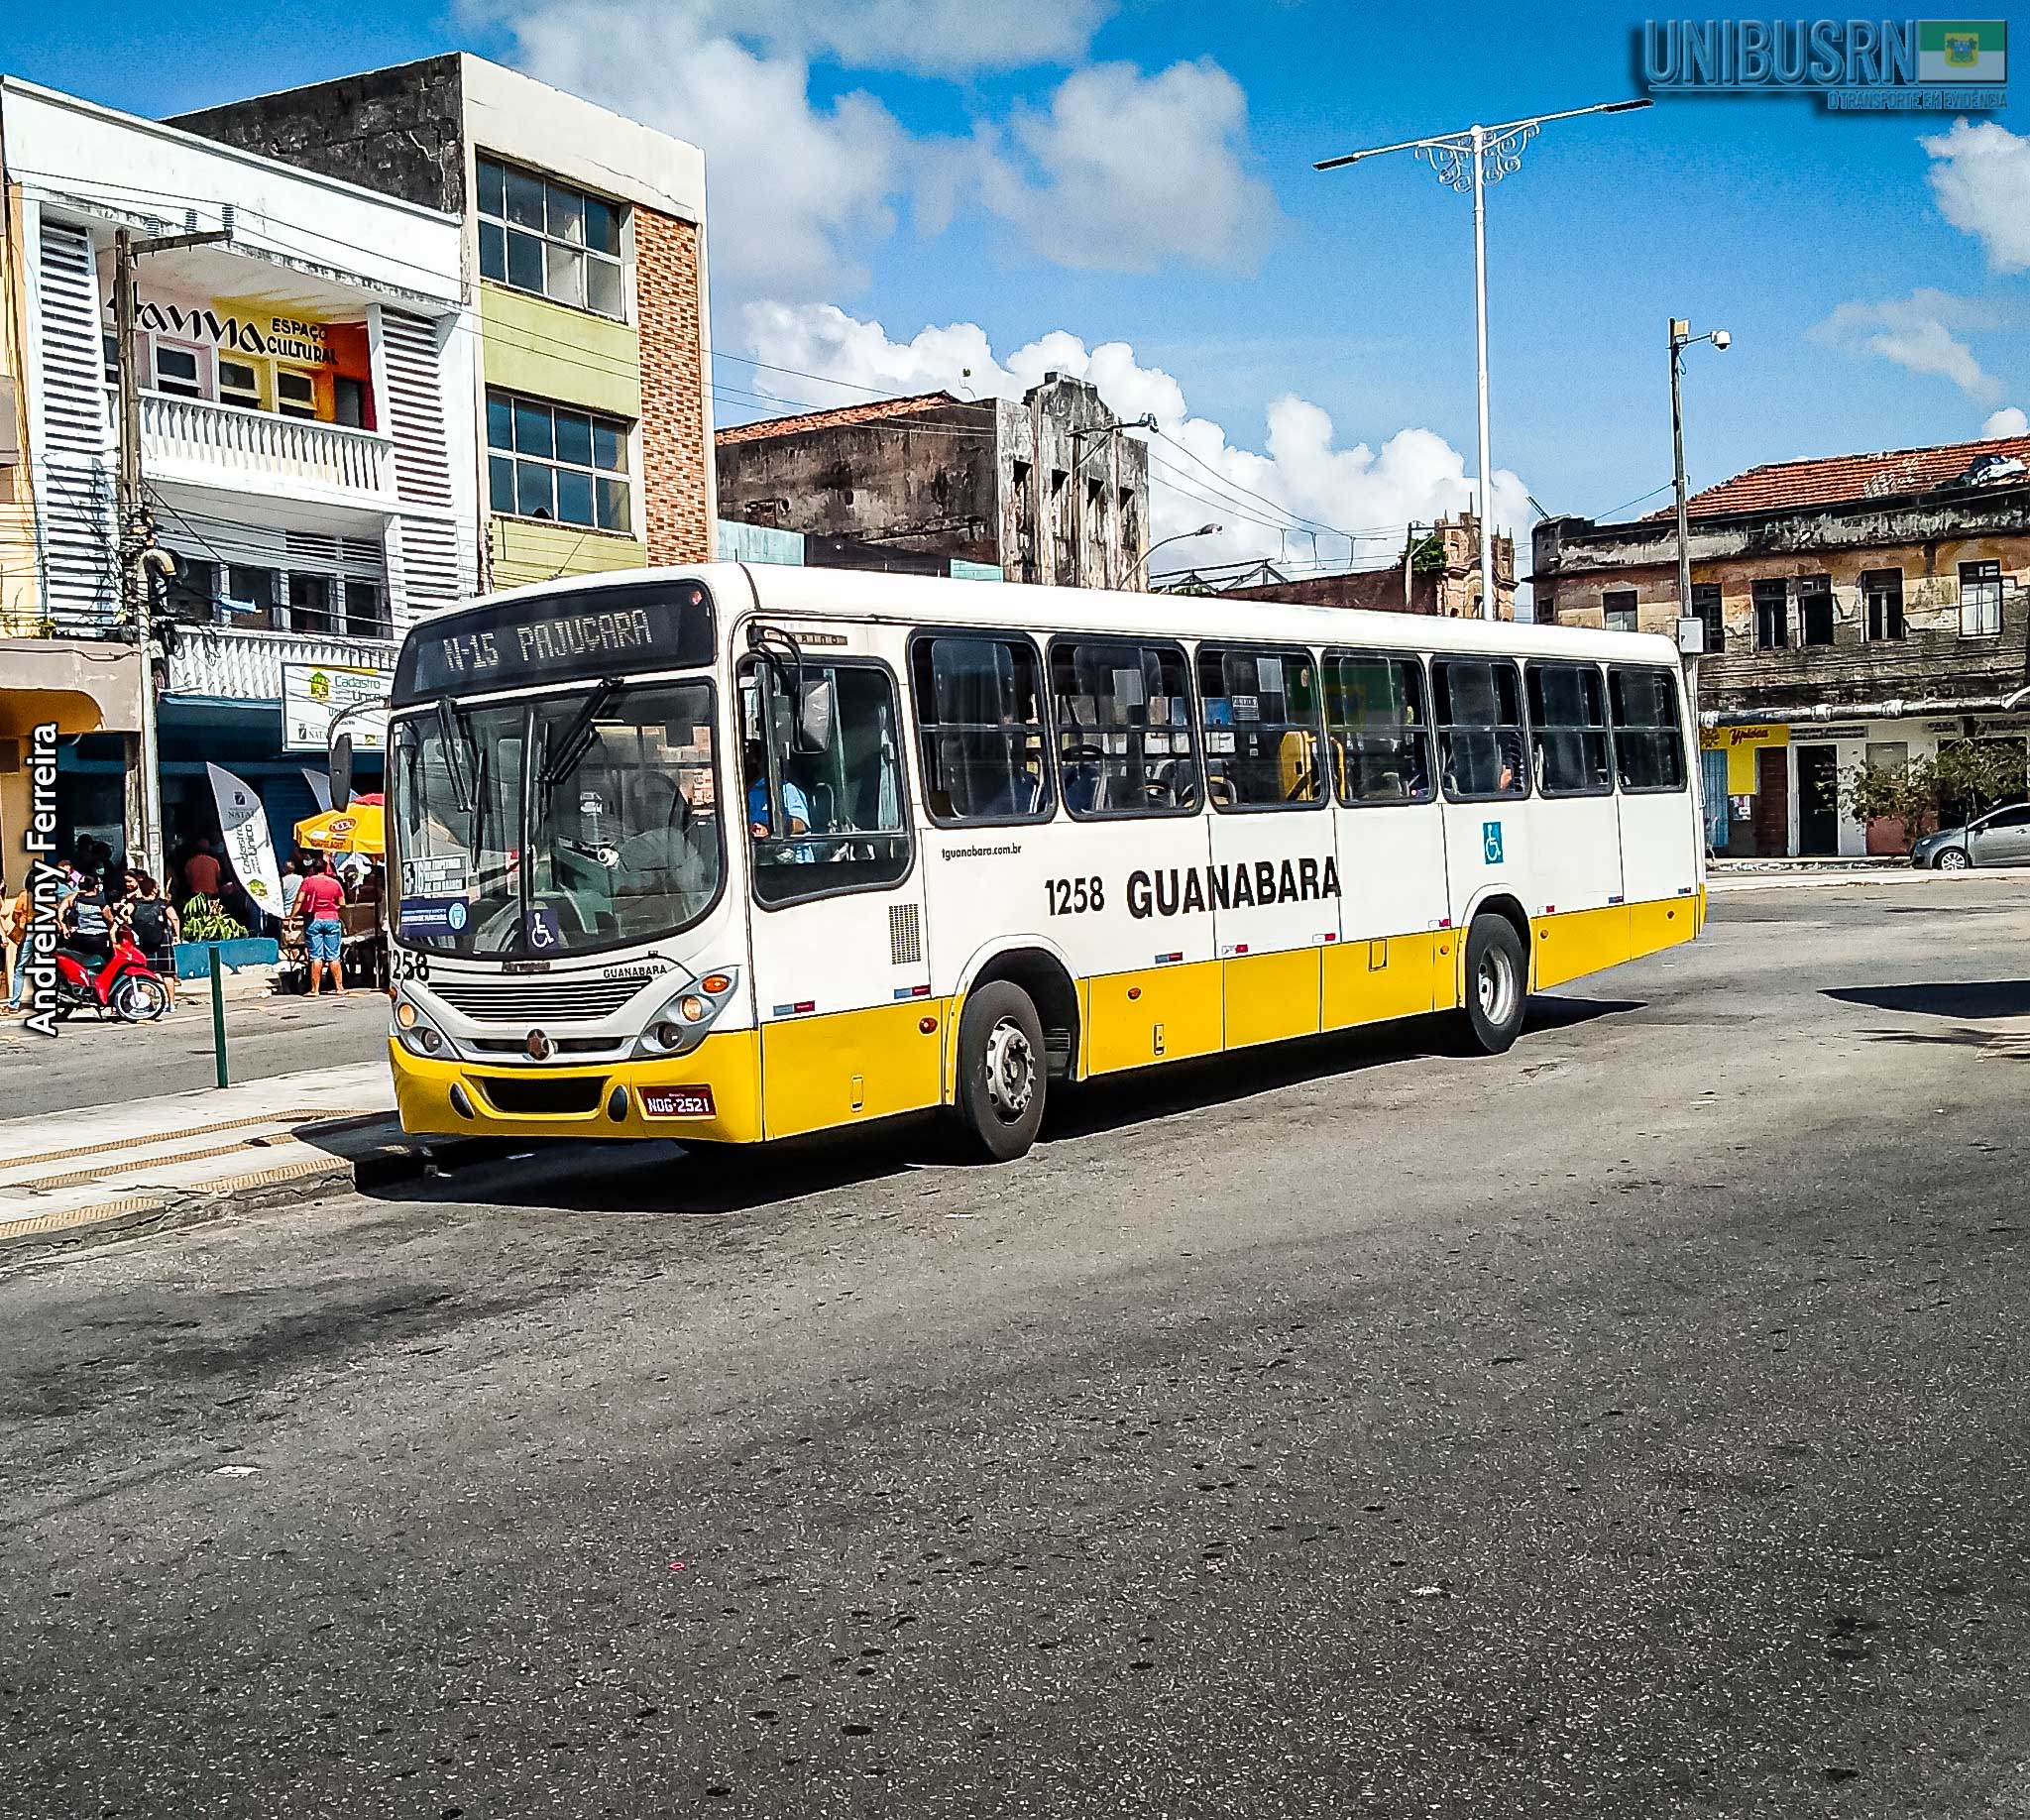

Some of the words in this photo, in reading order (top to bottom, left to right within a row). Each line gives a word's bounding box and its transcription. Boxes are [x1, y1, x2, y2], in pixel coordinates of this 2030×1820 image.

[271, 316, 329, 343] ESPAÇO
[266, 335, 339, 366] CULTURAL
[442, 631, 499, 672] N-15
[516, 609, 653, 662] PAJUÇARA
[335, 675, 381, 690] Cadastro
[942, 843, 1022, 861] tguanabara.com.br
[1044, 875, 1105, 916] 1258
[1126, 855, 1342, 920] GUANABARA
[603, 964, 668, 979] GUANABARA
